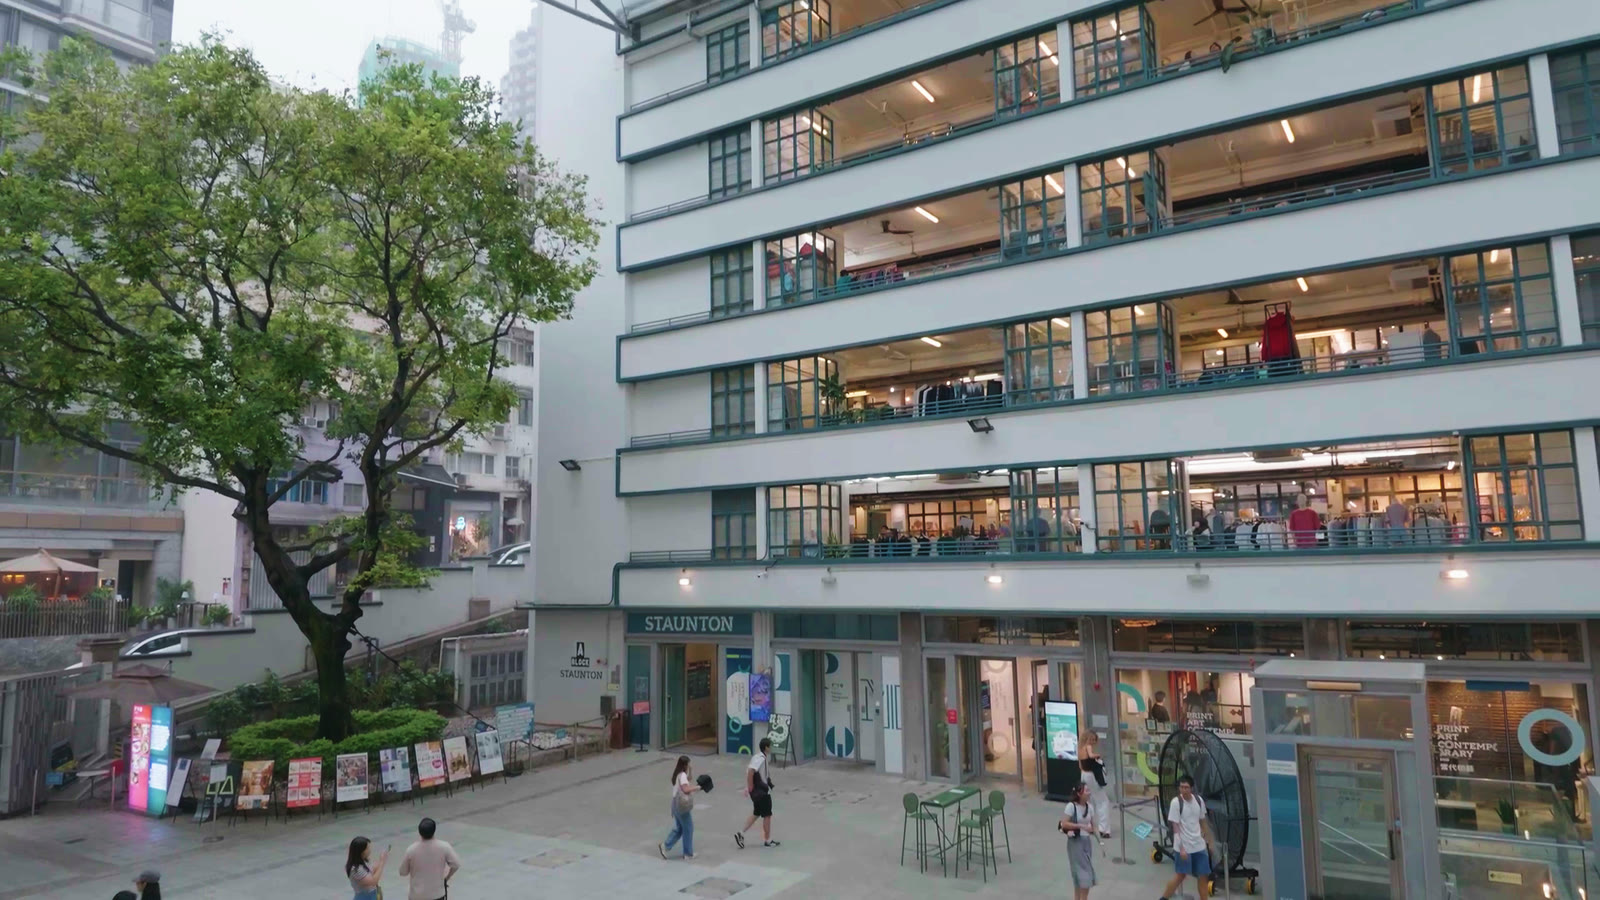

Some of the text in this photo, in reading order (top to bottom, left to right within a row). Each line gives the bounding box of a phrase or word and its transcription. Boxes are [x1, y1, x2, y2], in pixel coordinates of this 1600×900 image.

[645, 616, 734, 632] STAUNTON
[577, 643, 583, 656] A
[571, 658, 589, 666] BLOCK
[560, 669, 603, 680] STAUNTON
[1436, 725, 1469, 733] PRINT
